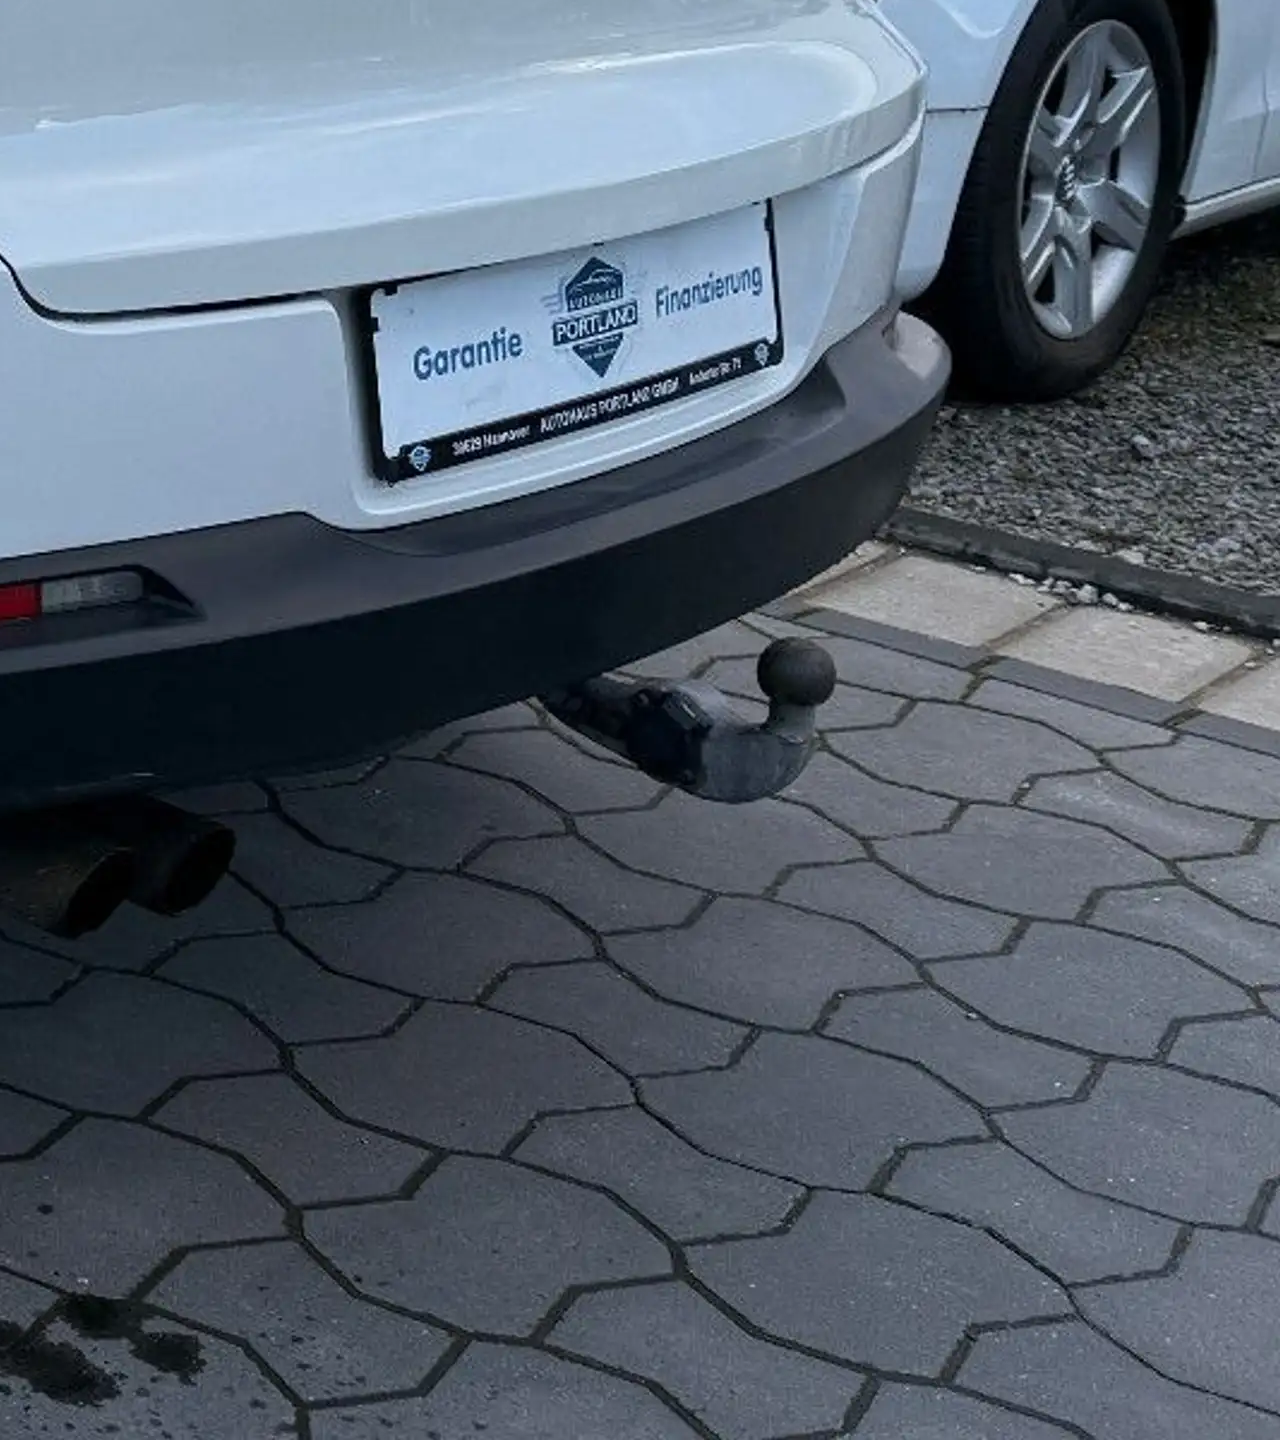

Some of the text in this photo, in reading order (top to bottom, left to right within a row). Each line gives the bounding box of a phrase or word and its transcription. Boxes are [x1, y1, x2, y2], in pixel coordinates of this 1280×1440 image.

[656, 266, 762, 318] Finanzierung
[555, 304, 636, 342] PORTLAND
[413, 327, 523, 381] Garantie
